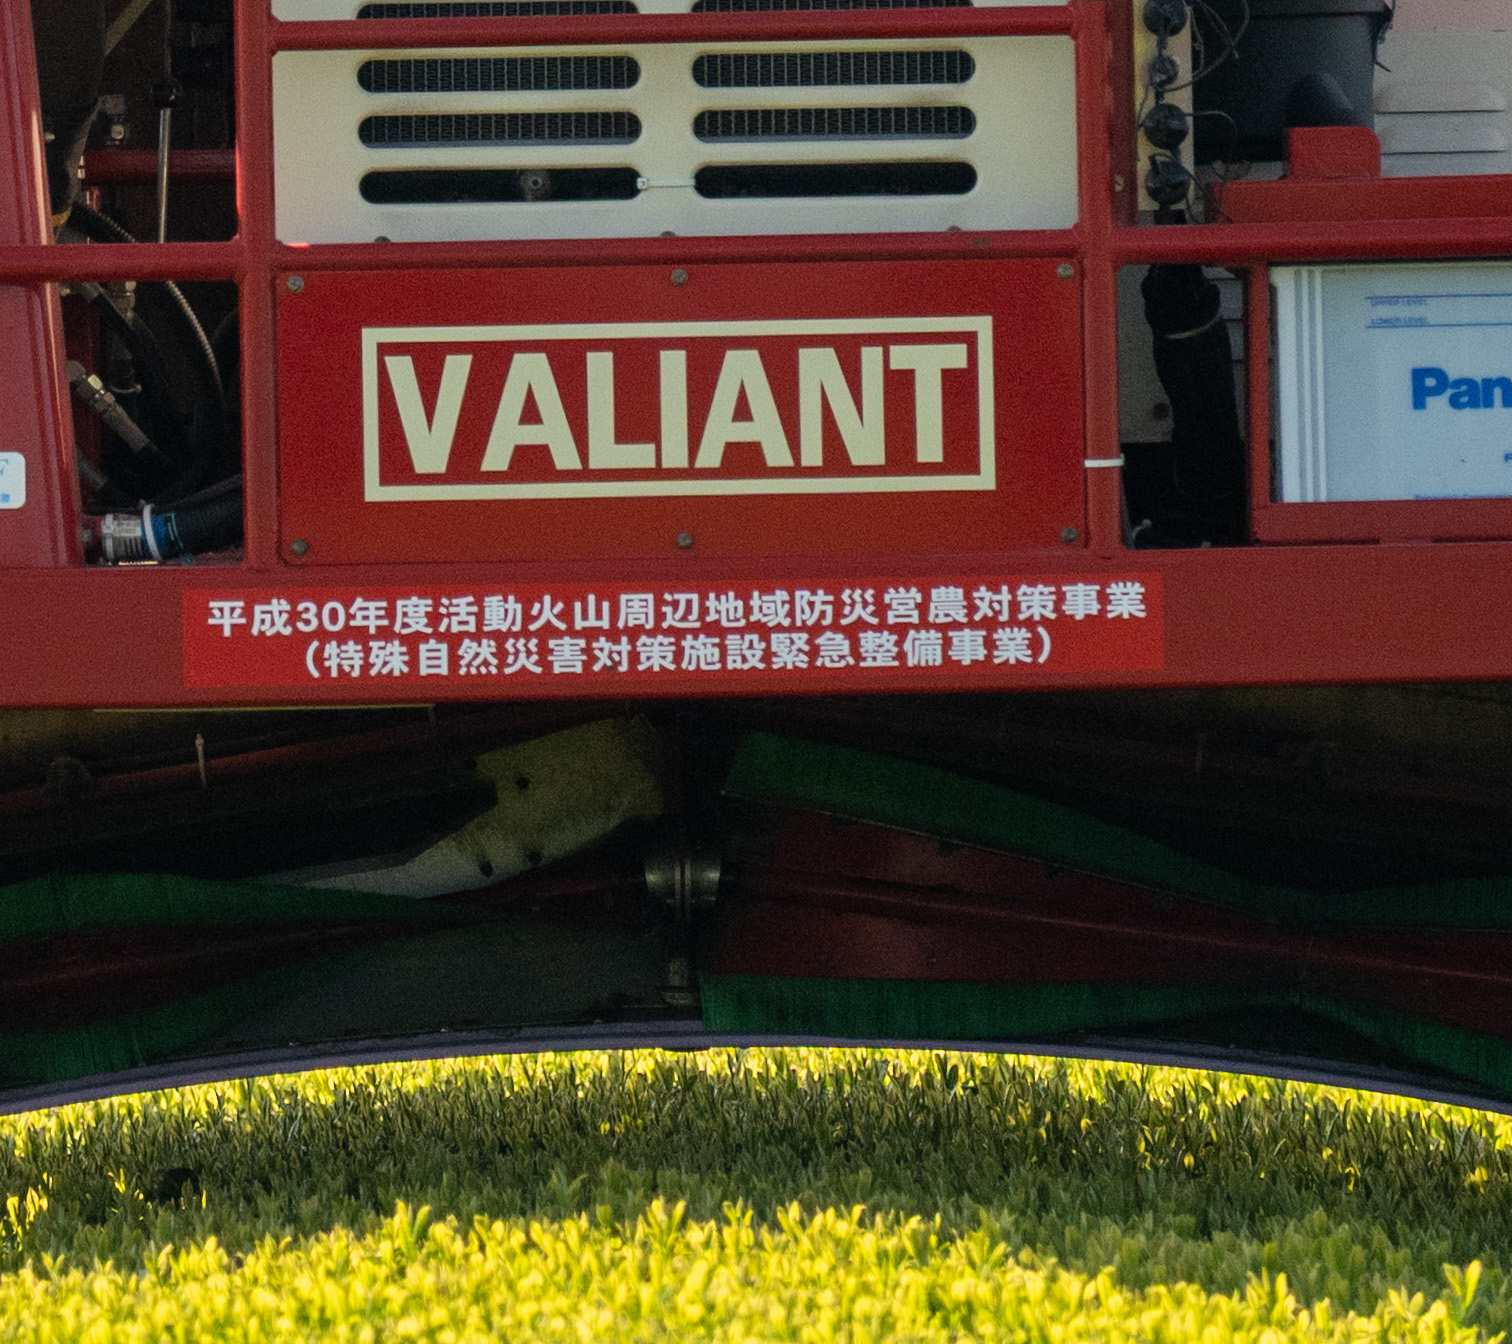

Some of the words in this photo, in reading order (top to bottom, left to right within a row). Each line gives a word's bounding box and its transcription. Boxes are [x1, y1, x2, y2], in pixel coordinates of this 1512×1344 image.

[384, 343, 968, 474] VALIANT
[207, 581, 1147, 637] 平成30年度活動火山周辺地域防災営農対策事業
